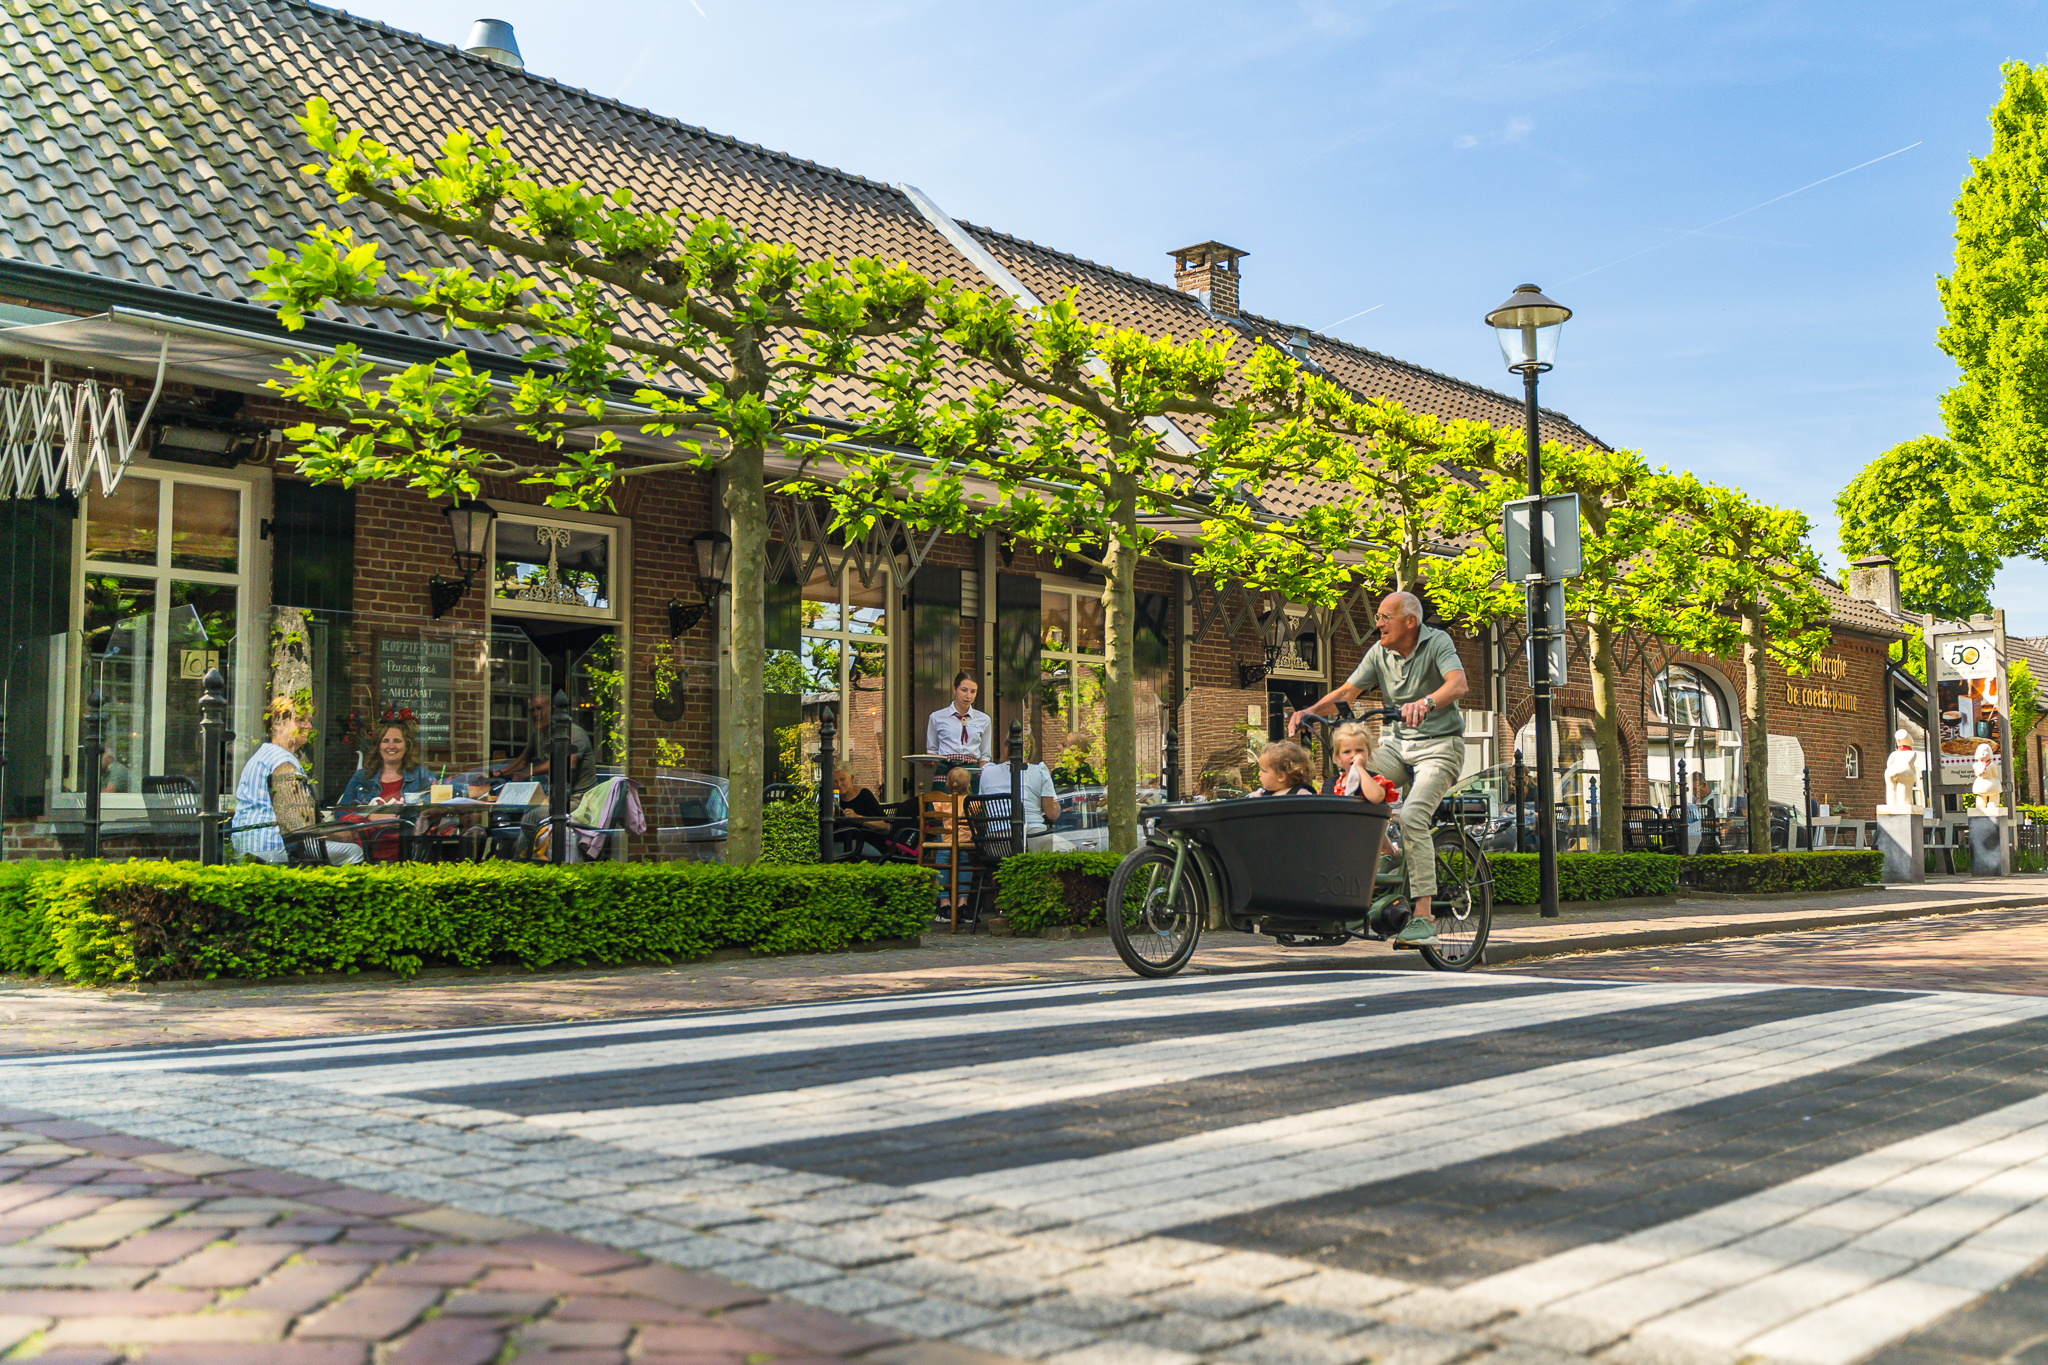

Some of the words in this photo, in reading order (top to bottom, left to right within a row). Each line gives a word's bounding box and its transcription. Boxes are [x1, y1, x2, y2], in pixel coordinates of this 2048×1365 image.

[1951, 644, 1980, 666] 50
[1786, 681, 1799, 705] de
[1802, 684, 1858, 714] coeckepanne
